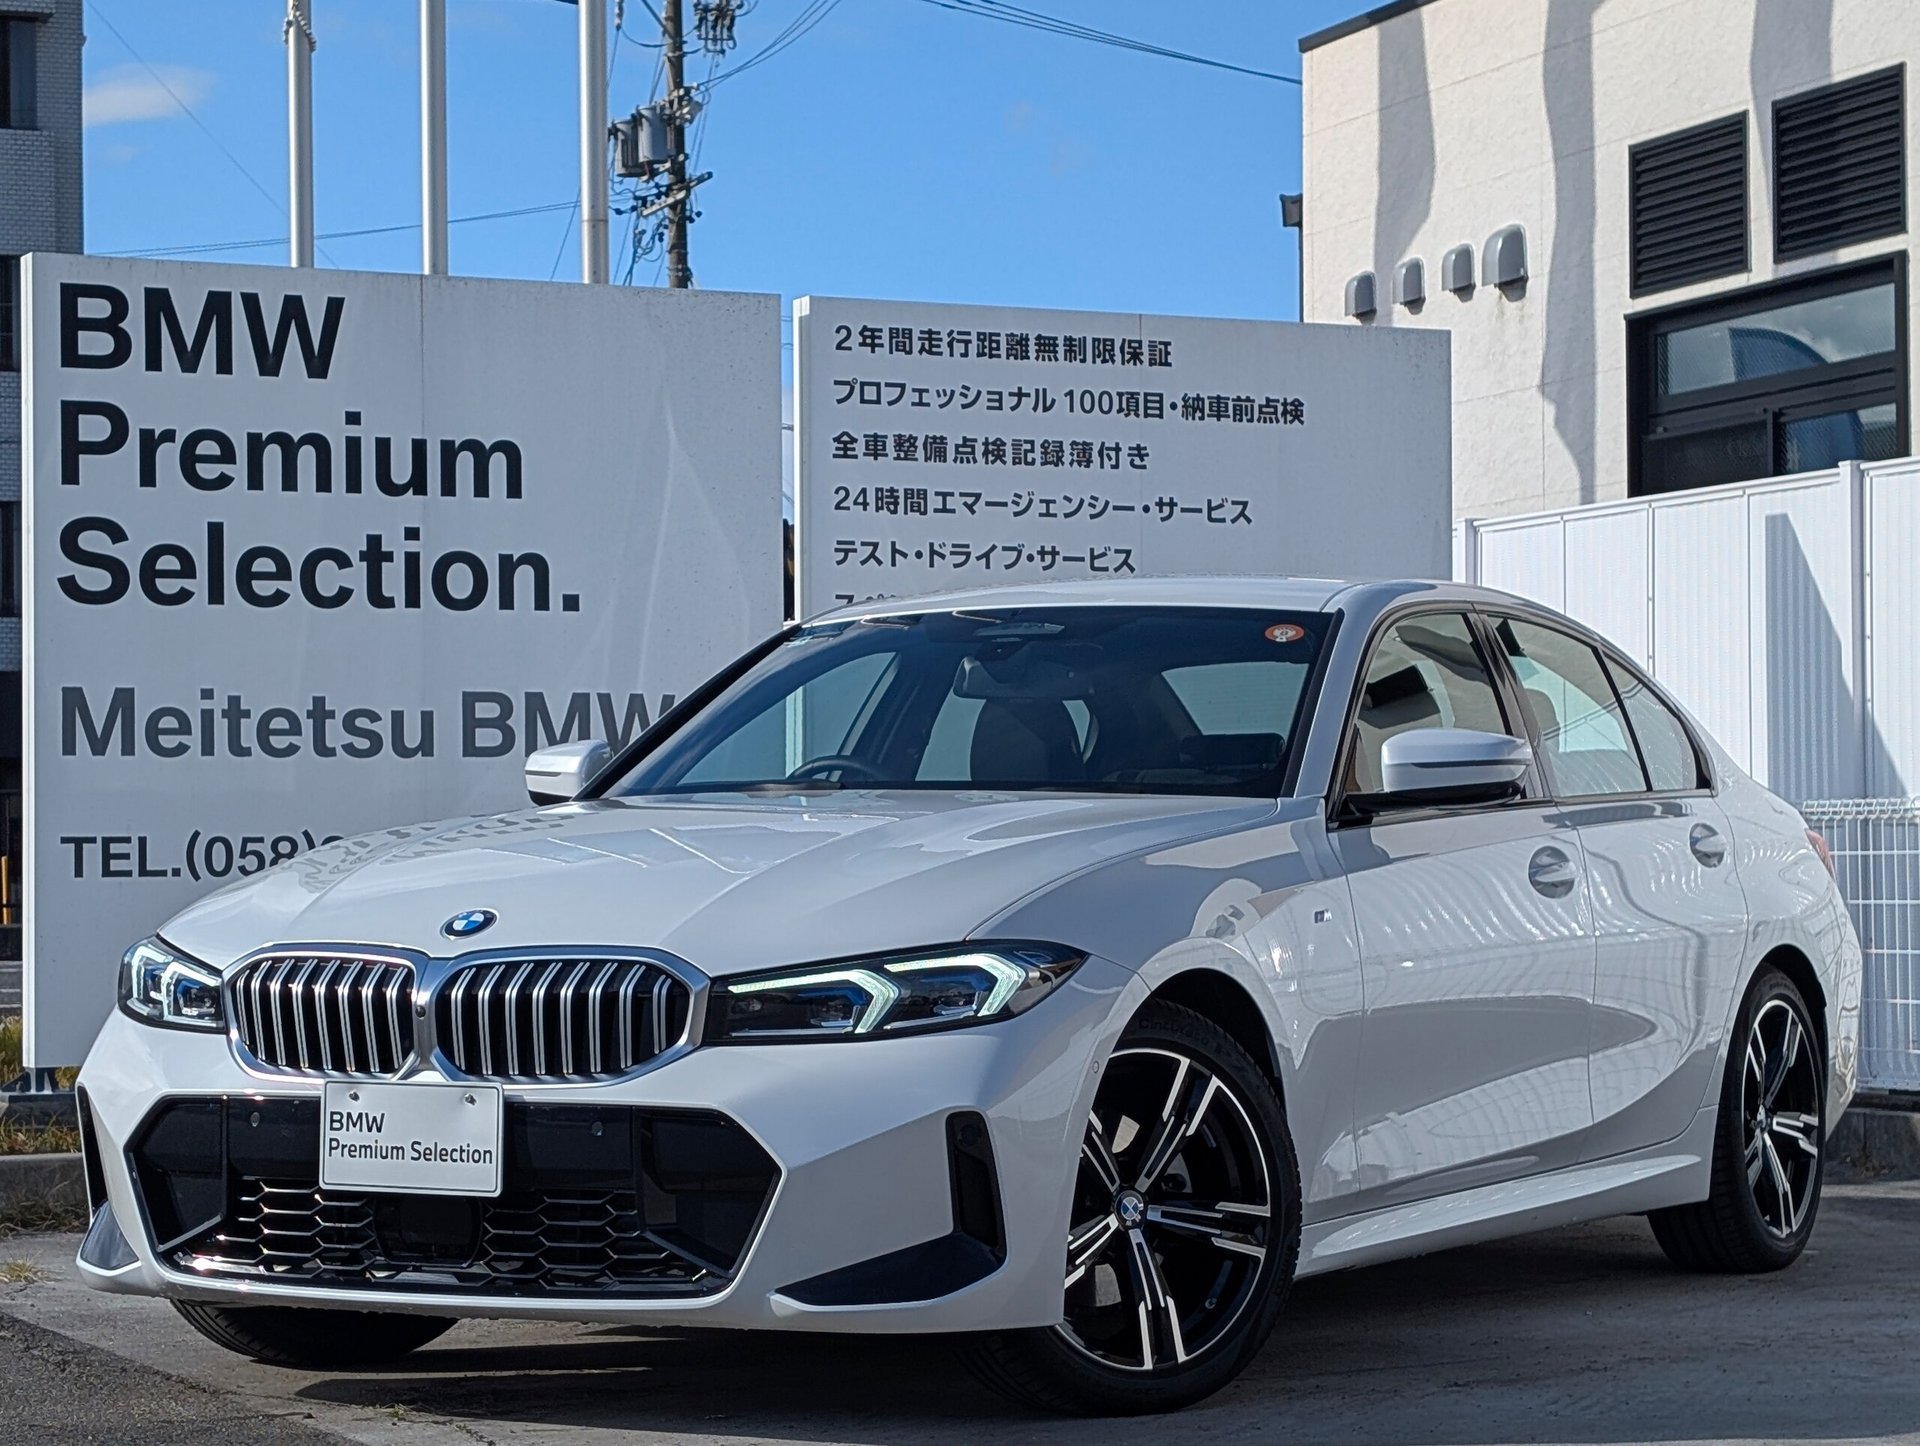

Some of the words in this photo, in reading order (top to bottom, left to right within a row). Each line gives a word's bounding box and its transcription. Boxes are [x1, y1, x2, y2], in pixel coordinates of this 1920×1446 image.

[59, 282, 346, 380] BMW
[834, 324, 1173, 368] 2年間走行距離無制限保証
[60, 399, 523, 500] Premium
[832, 430, 1150, 470] 全車整備点検記録簿付き
[833, 485, 1253, 525] 24時間エマージェンシー・サービス
[56, 516, 581, 612] Selection.
[834, 539, 1136, 574] テスト・ドライブ・サービス
[61, 686, 435, 759] Meitetsu
[461, 690, 676, 758] BMW
[60, 829, 345, 882] TEL.(058
[329, 1110, 386, 1134] BMW
[328, 1137, 405, 1161] Premium
[410, 1140, 493, 1165] Selection
